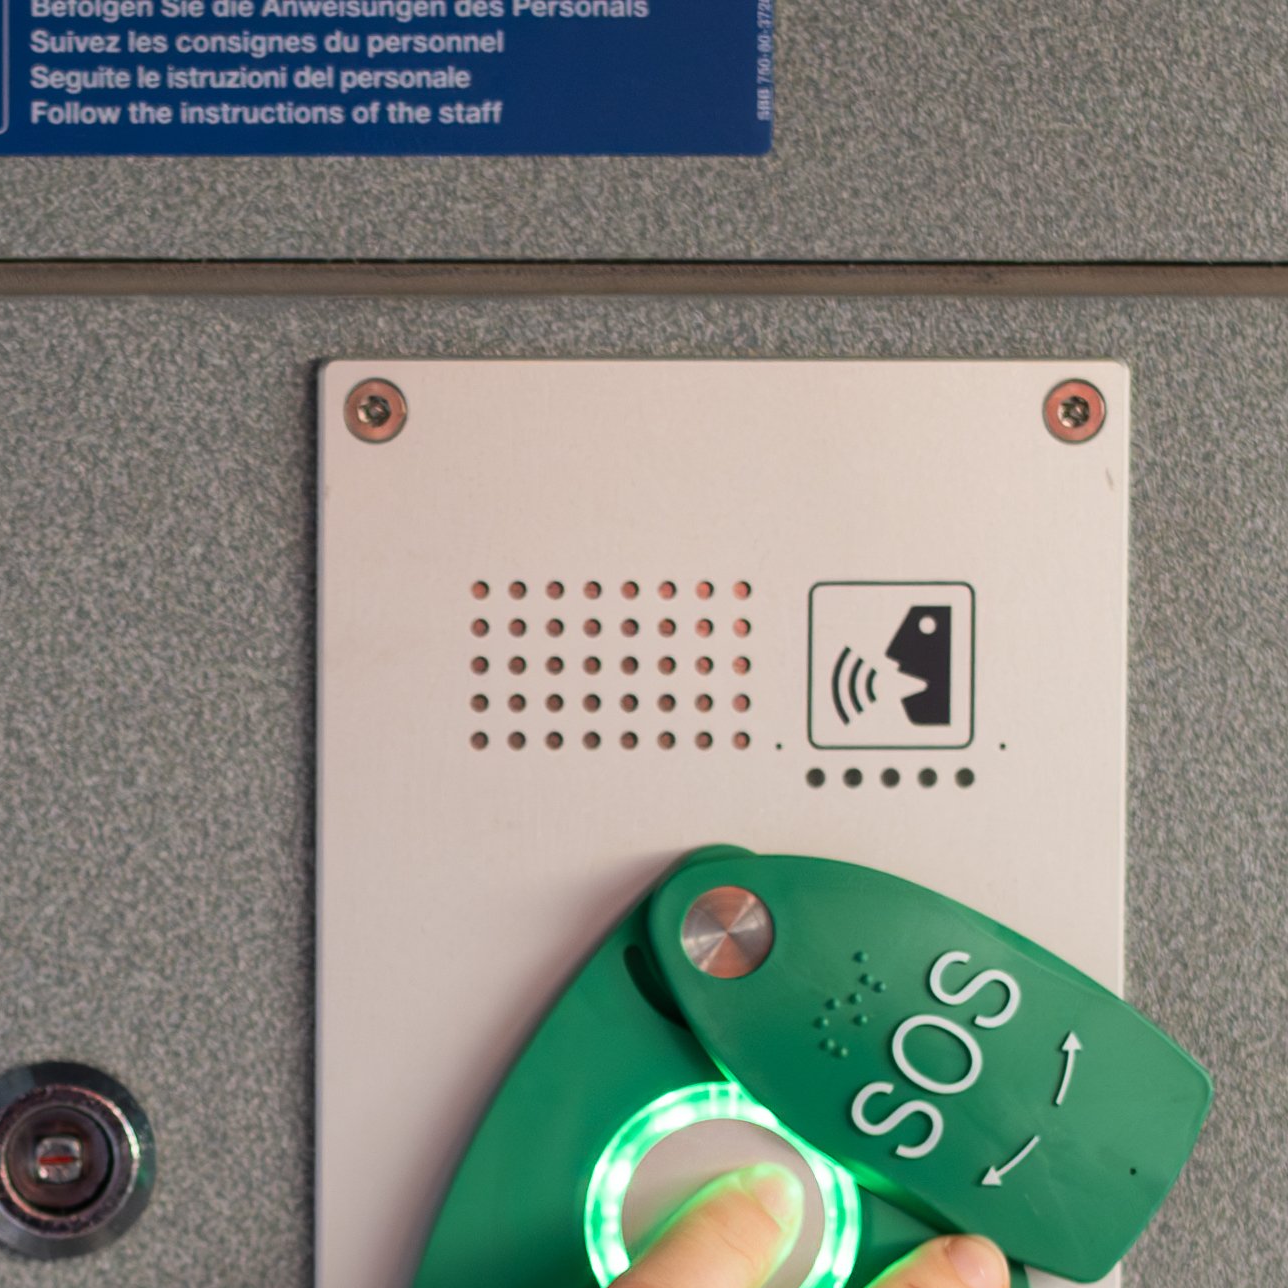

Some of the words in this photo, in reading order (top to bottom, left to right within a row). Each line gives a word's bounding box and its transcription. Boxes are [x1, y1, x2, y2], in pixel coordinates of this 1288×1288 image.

[31, 0, 153, 22] Befolgen
[161, 0, 204, 17] Sie
[213, 0, 253, 17] die
[261, 0, 446, 22] Anweisungen
[455, 0, 504, 17] des
[513, 0, 649, 17] Personals
[30, 30, 121, 52] Suivez
[128, 30, 168, 52] les
[175, 30, 316, 58] consignes
[325, 30, 359, 52] du
[368, 30, 504, 58] personnel
[30, 66, 131, 94] Seguite
[137, 66, 161, 88] le
[167, 66, 287, 88] istruzioni
[293, 66, 333, 88] del
[340, 66, 471, 93] personale
[31, 102, 121, 124] Follow
[128, 102, 172, 124] the
[181, 102, 344, 124] instructions
[352, 102, 380, 124] of
[387, 102, 431, 124] the
[438, 102, 503, 124] staff
[850, 951, 1021, 1159] SOS
